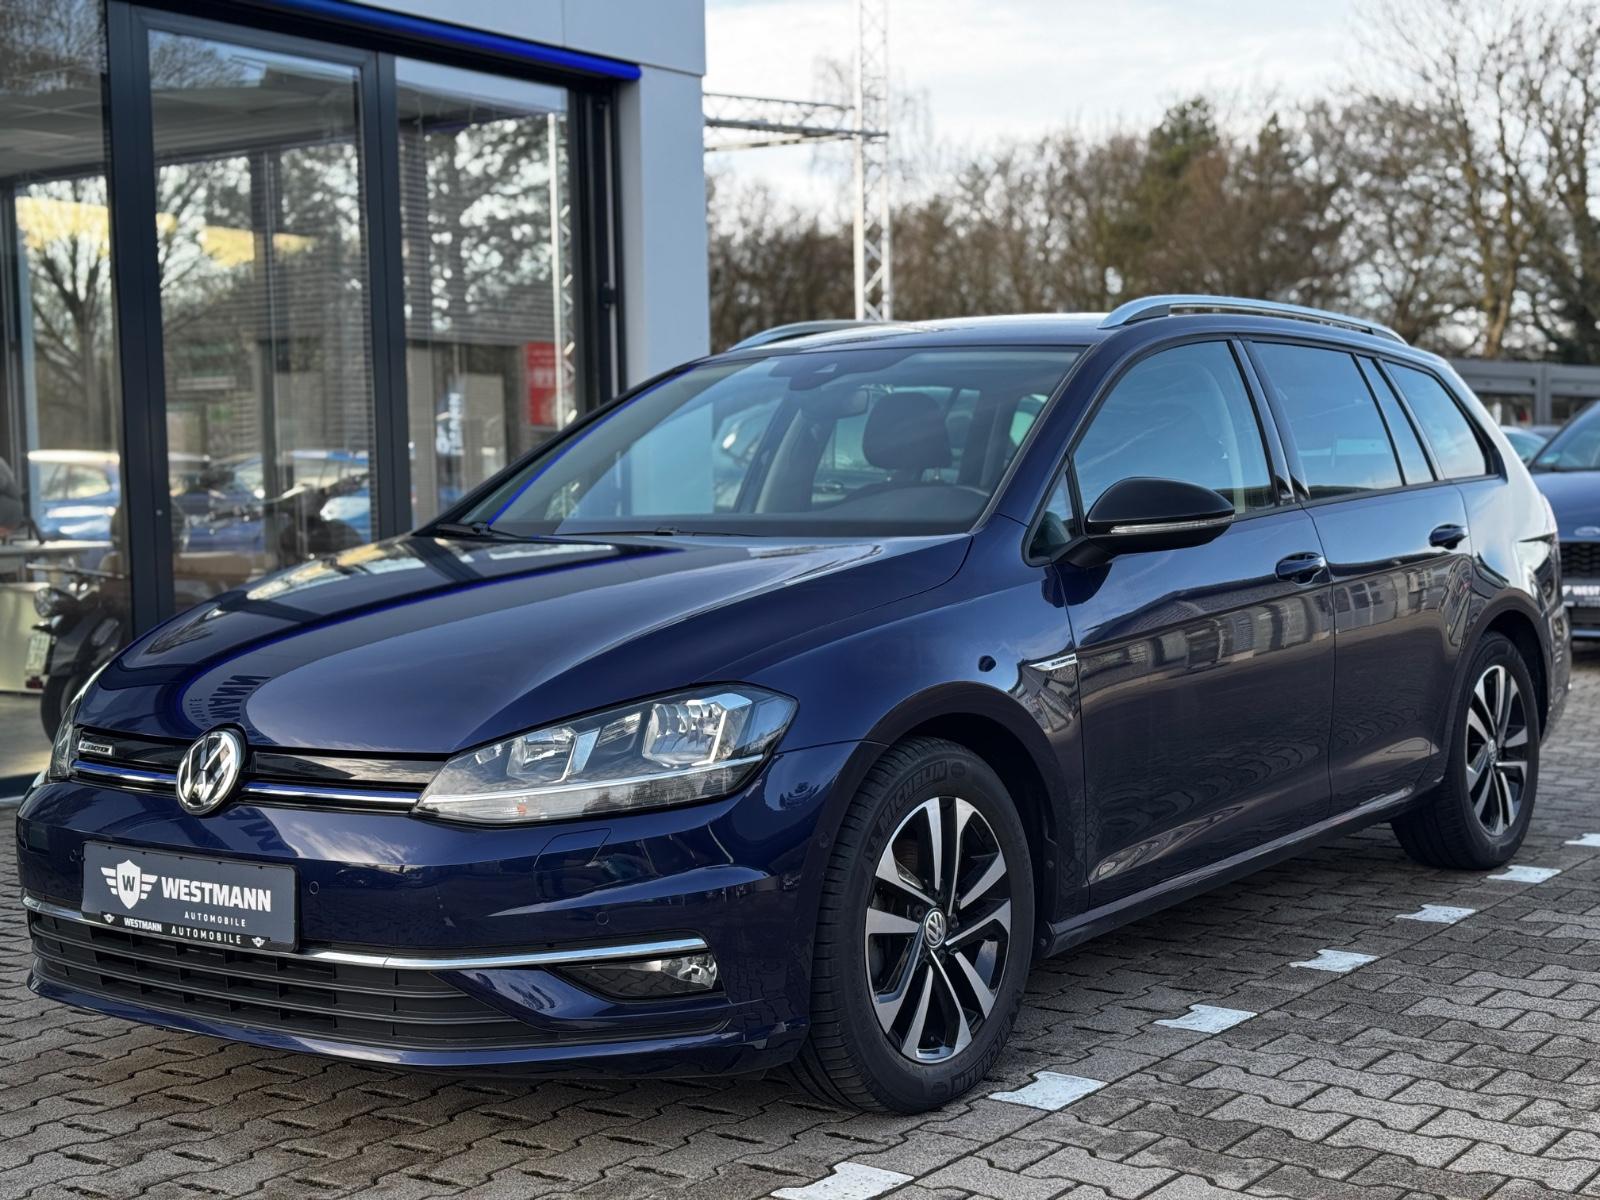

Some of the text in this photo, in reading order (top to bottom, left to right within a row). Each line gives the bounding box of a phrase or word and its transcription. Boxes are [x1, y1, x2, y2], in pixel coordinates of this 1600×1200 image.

[161, 876, 272, 912] WESTMANN
[123, 917, 241, 944] WESTMANN AUTOMOBILE
[184, 911, 246, 927] AUTOMOBILE
